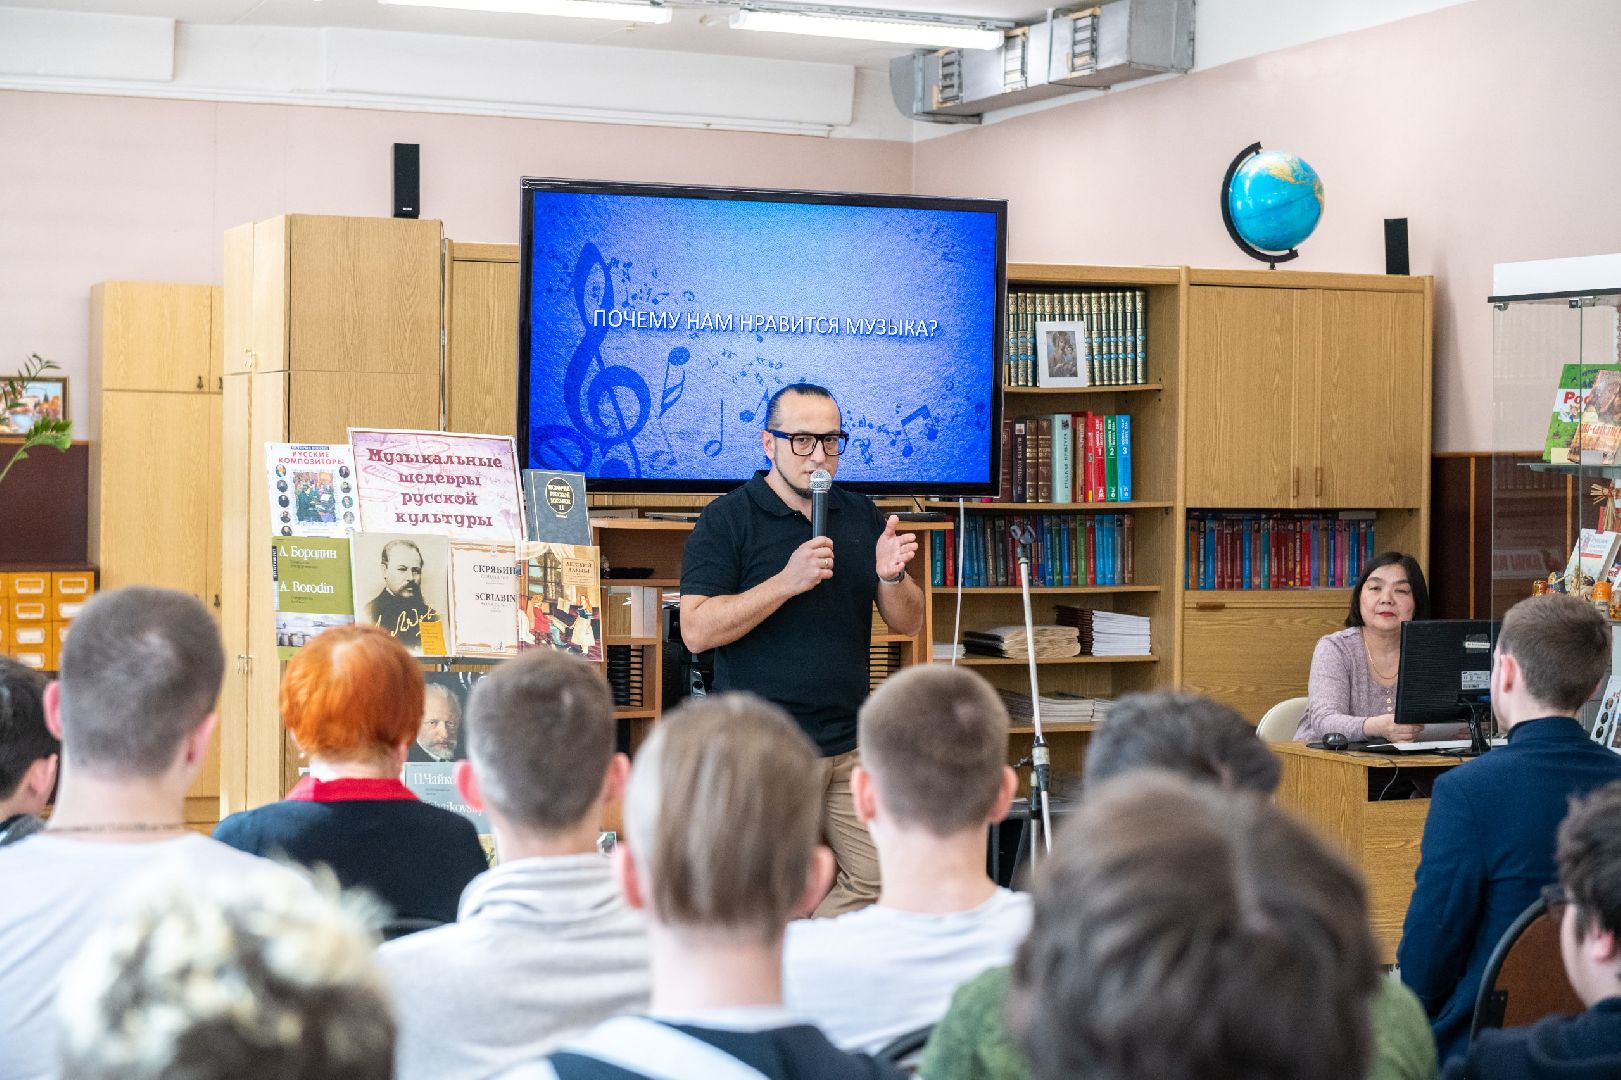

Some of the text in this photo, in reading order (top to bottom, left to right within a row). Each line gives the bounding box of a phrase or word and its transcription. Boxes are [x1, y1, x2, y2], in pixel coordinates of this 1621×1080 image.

[593, 309, 939, 338] ПОЧЕМУ НАМ НРАВИТСЯ МУЗЫКА?
[367, 447, 503, 468] Музыкальные
[1109, 447, 1115, 456] 2
[1122, 447, 1128, 455] 3
[278, 457, 345, 465] КОМПОЗИТОРЫ
[398, 471, 482, 488] шедевры
[401, 491, 479, 507] русской
[395, 512, 494, 529] культуры
[290, 545, 337, 561] Бородин
[279, 580, 335, 594] A. Borodin
[475, 592, 517, 603] SCRIABIN
